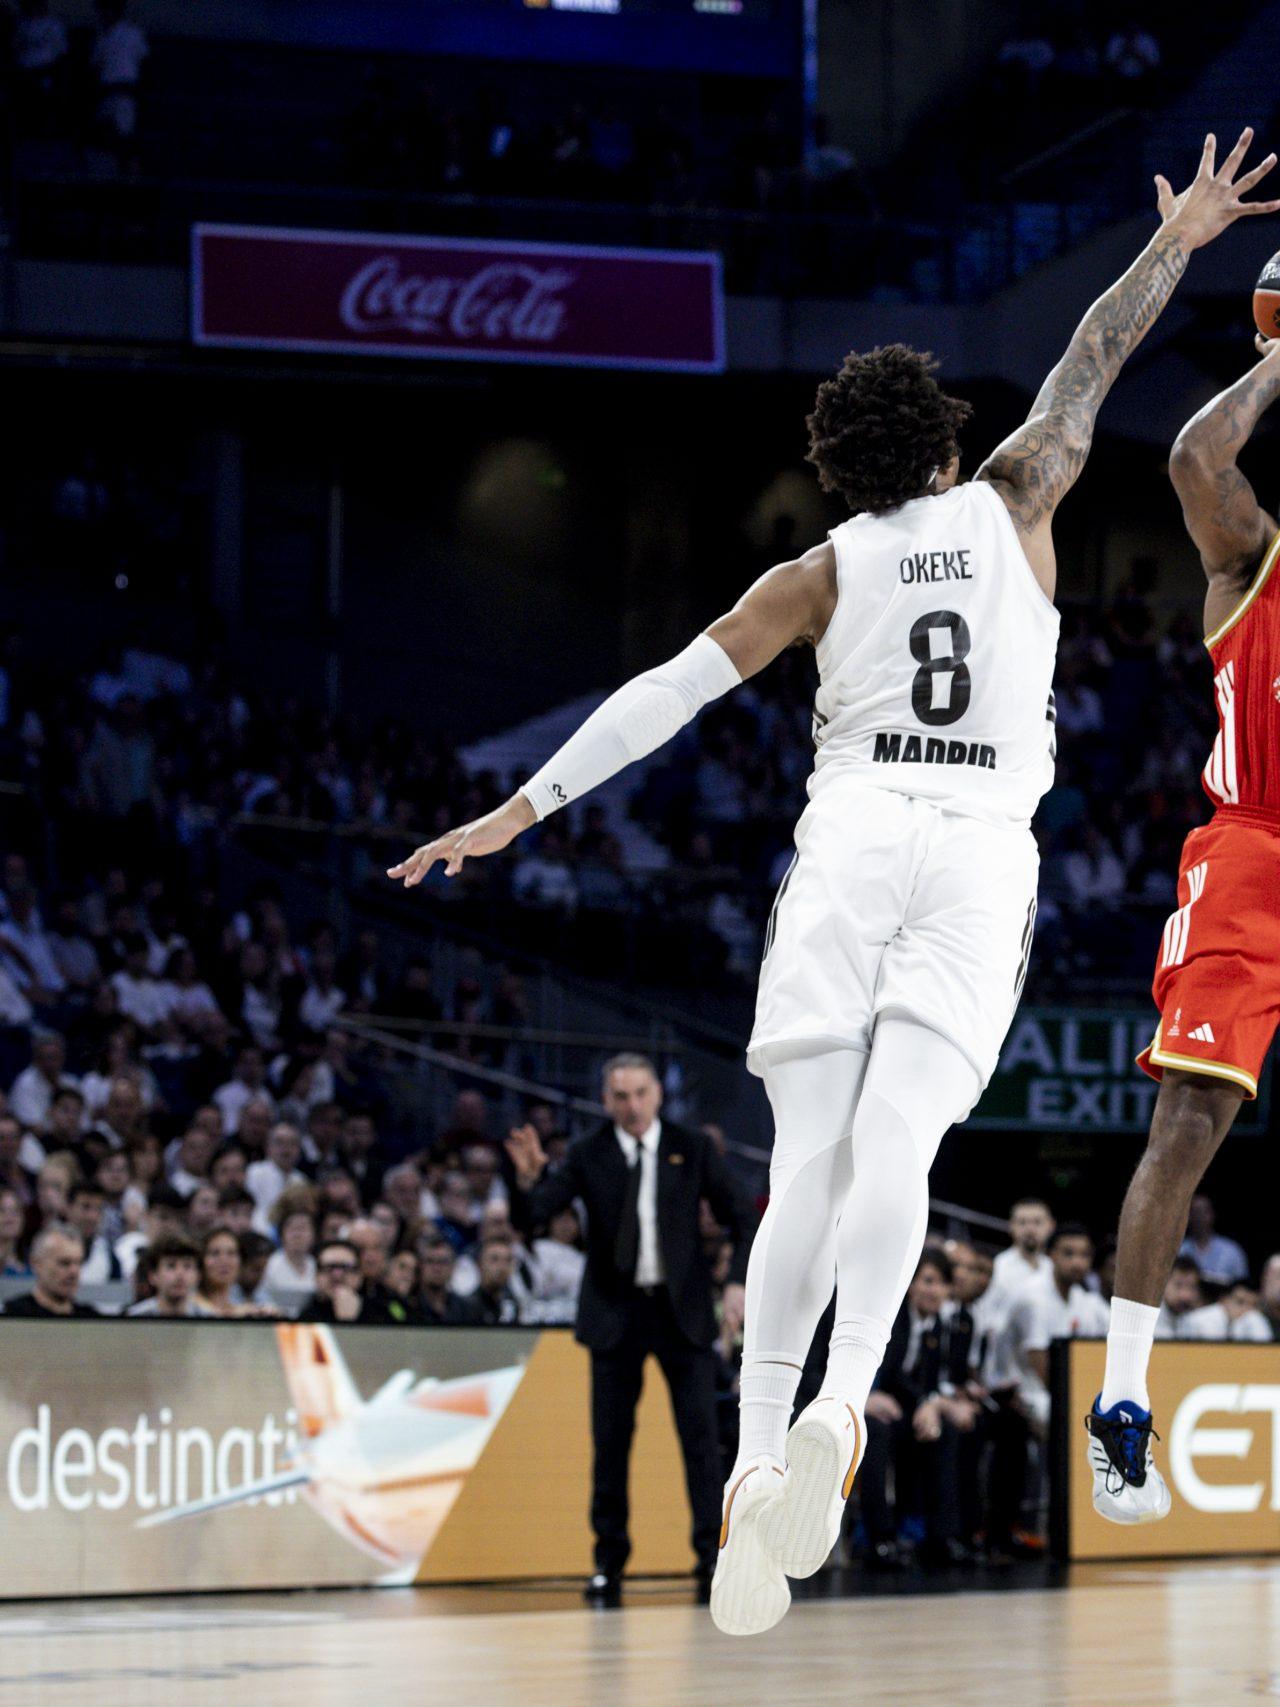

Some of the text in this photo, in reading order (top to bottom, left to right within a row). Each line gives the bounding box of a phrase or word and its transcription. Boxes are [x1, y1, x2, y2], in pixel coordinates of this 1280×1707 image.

[899, 549, 973, 585] OKEKE
[909, 609, 972, 727] 8
[1000, 1014, 1152, 1076] ALI
[1028, 1079, 1158, 1125] EXIT
